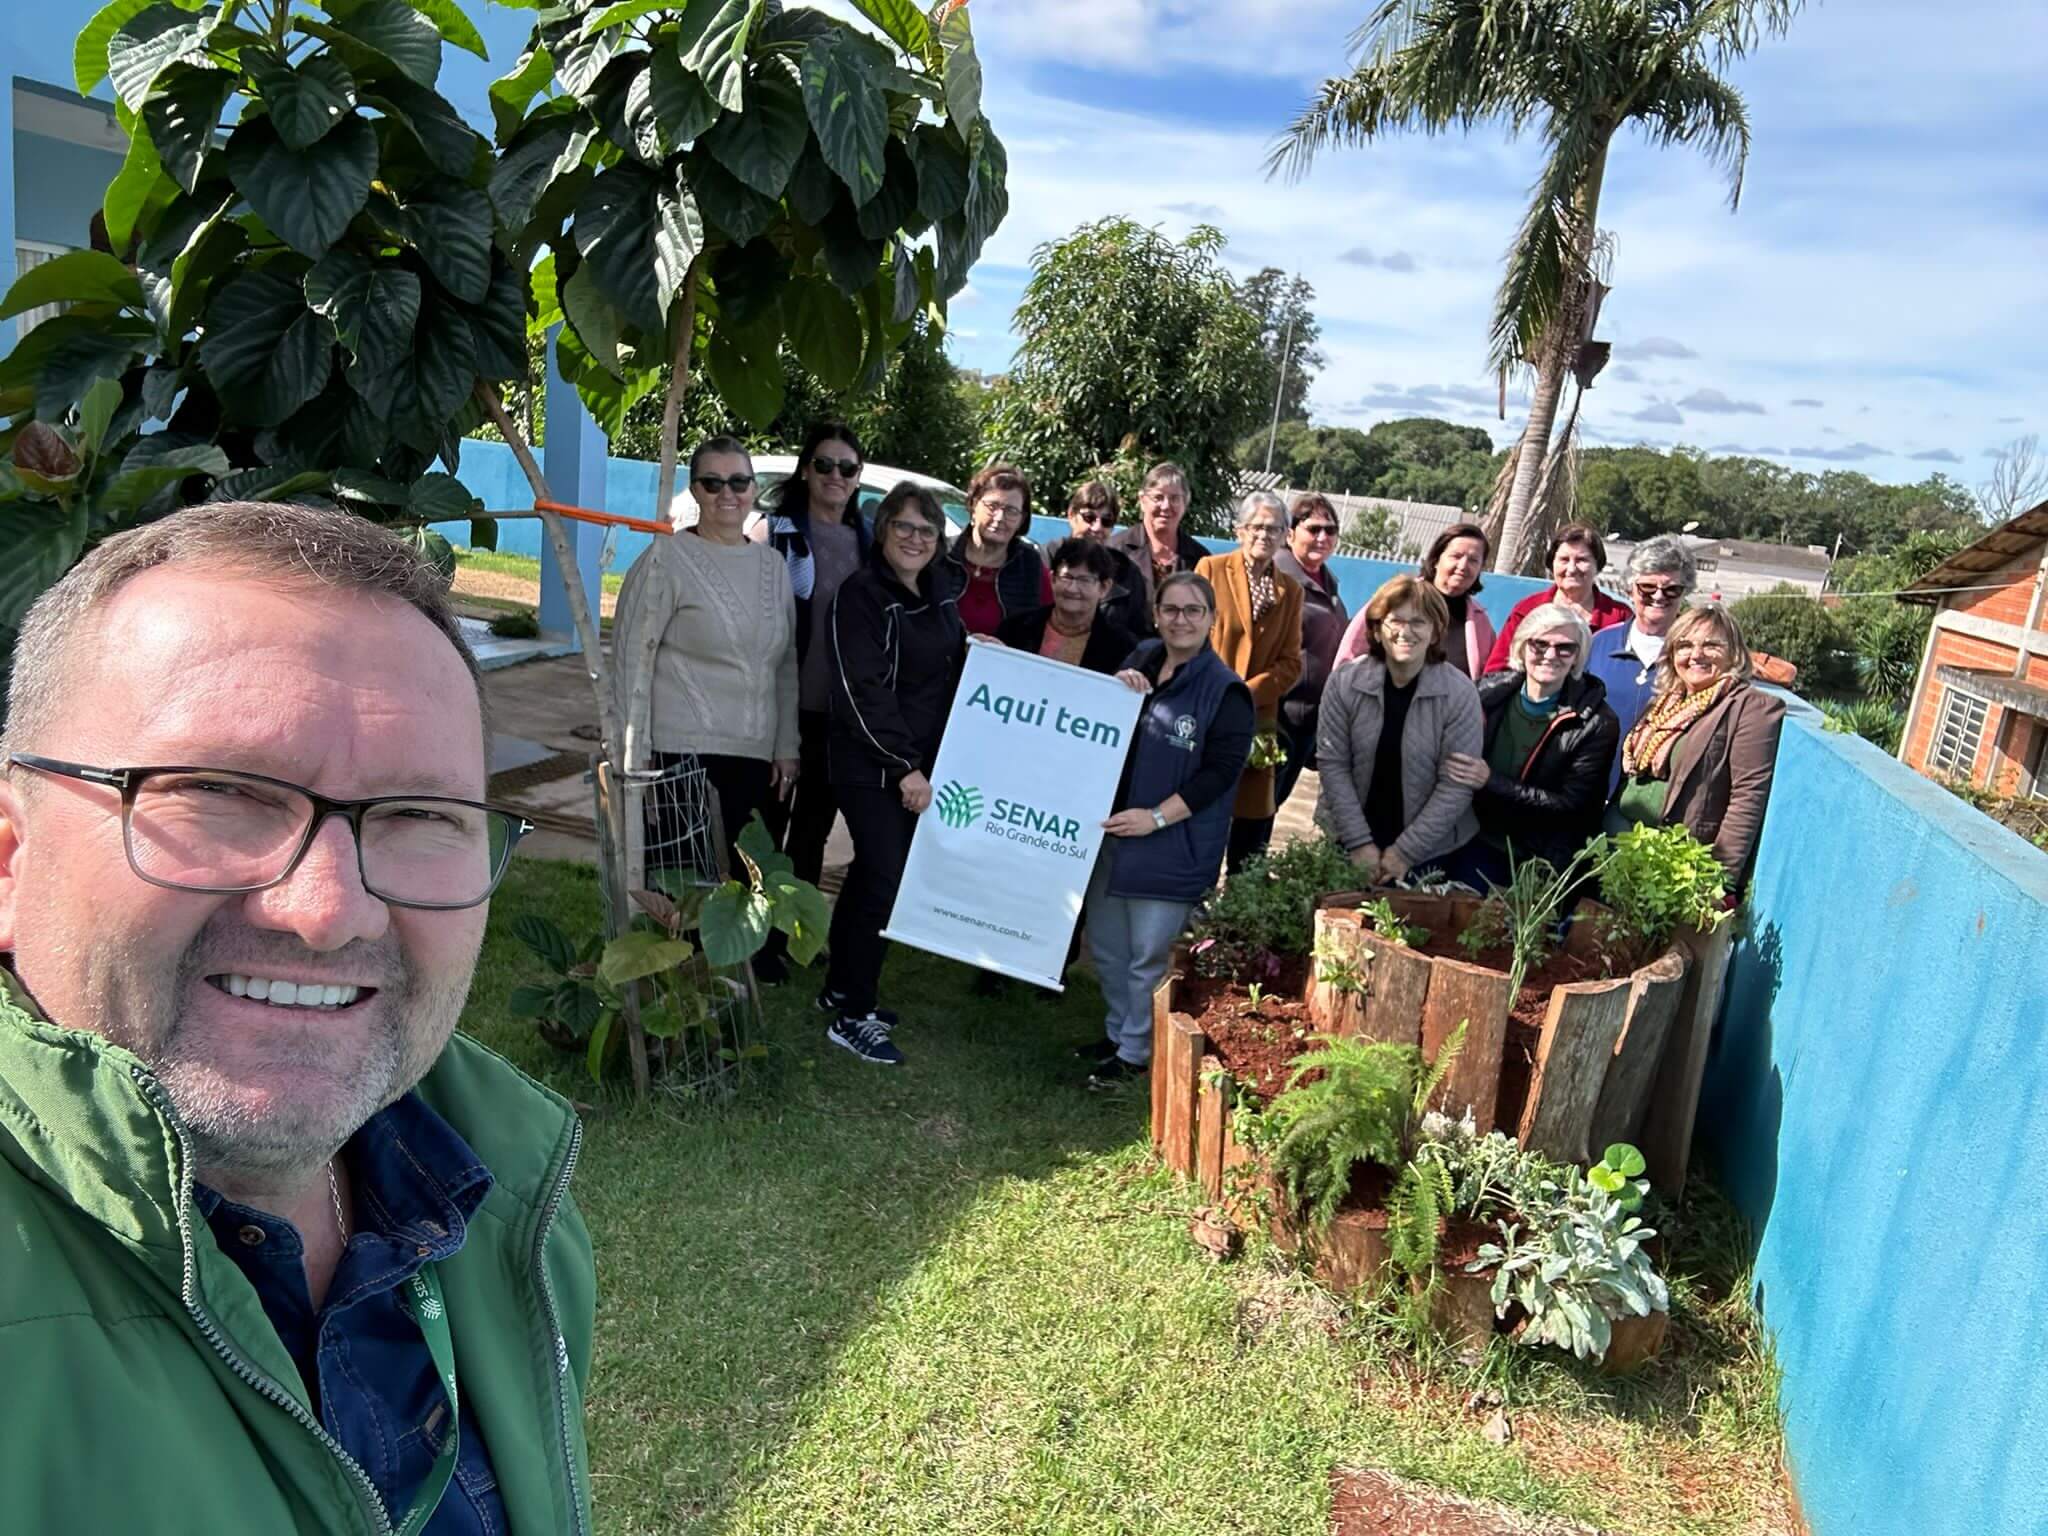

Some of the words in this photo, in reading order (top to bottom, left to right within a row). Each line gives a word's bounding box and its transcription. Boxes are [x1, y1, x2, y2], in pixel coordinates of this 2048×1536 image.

[966, 683, 1049, 726] Aqui
[1055, 706, 1121, 748] tem
[985, 821, 1005, 836] Rio
[1006, 828, 1050, 850] Grande
[1050, 840, 1067, 854] do
[1067, 845, 1088, 860] Sul
[990, 798, 1081, 842] SENAR
[411, 1273, 429, 1298] SEN
